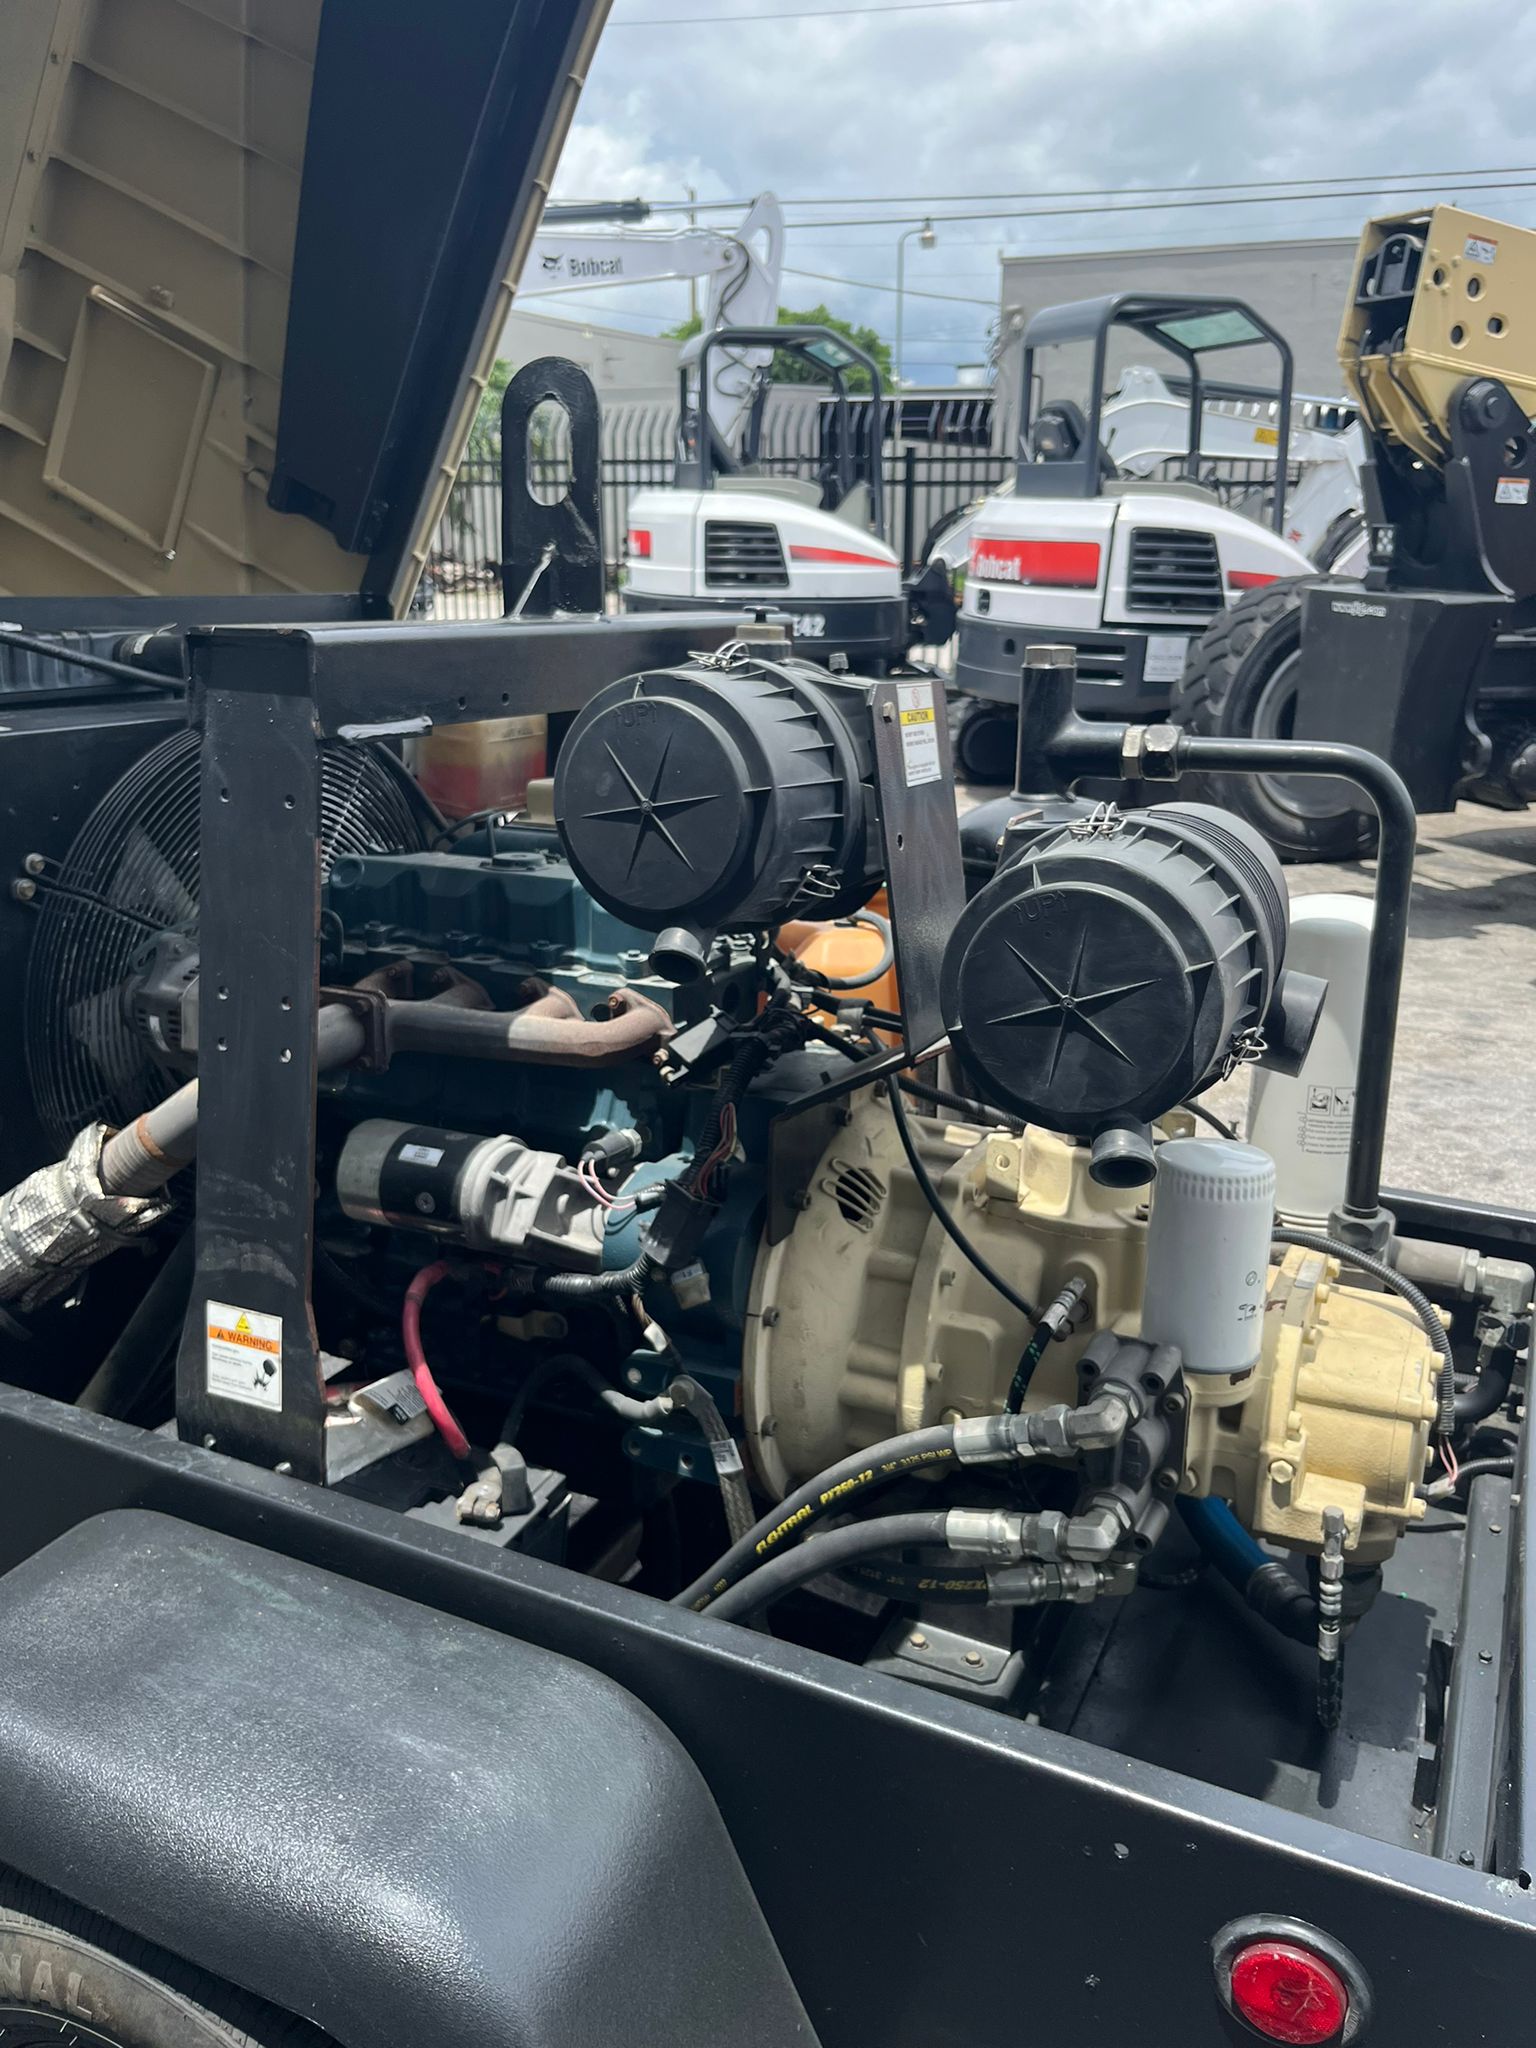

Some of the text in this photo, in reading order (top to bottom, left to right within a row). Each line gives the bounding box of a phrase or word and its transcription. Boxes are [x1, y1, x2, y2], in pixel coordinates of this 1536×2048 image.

[567, 256, 622, 277] Bobcat
[977, 554, 1022, 581] Bobcat
[228, 1331, 273, 1351] WARNING
